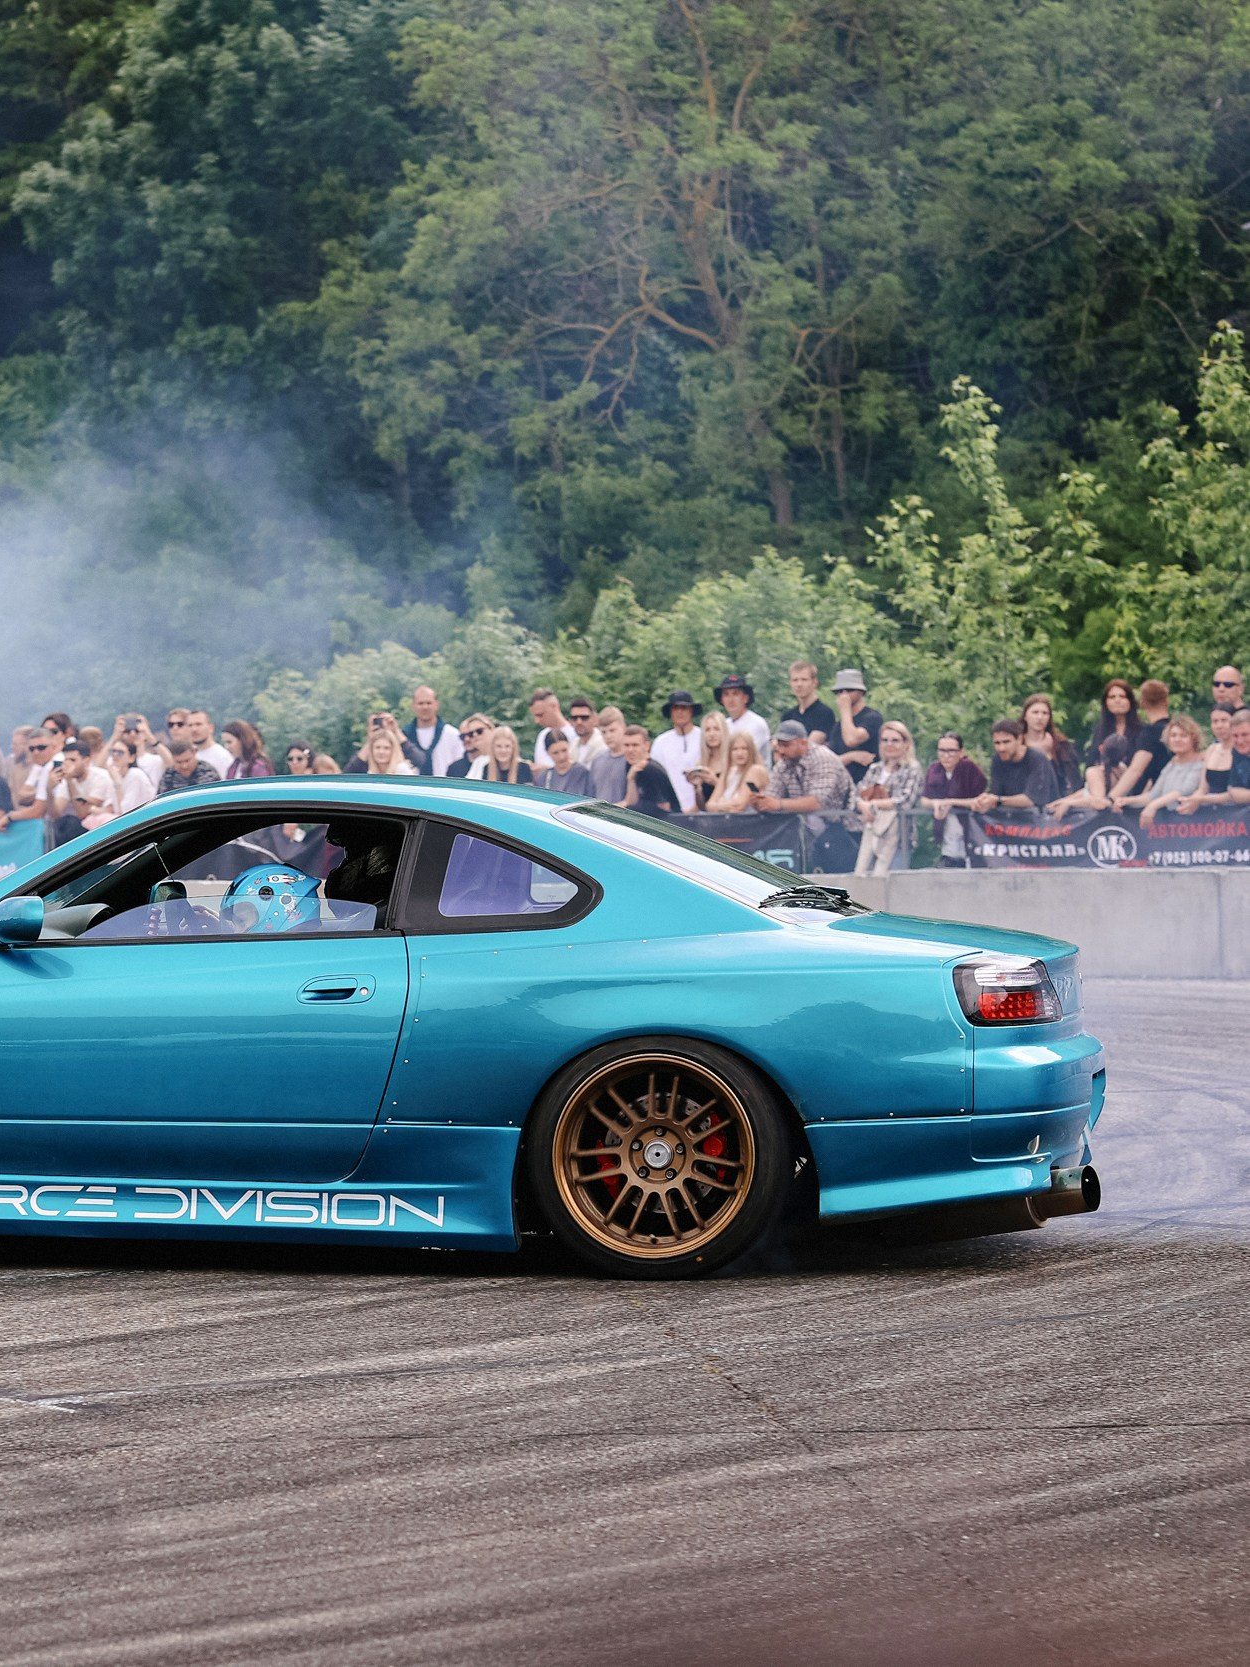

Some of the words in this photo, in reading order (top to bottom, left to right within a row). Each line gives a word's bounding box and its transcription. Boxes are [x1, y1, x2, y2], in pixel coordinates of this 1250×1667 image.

[984, 823, 1072, 838] КОМПЛЕКС
[1148, 819, 1249, 838] АВТОМОЙКА
[134, 1187, 444, 1228] DIVISION
